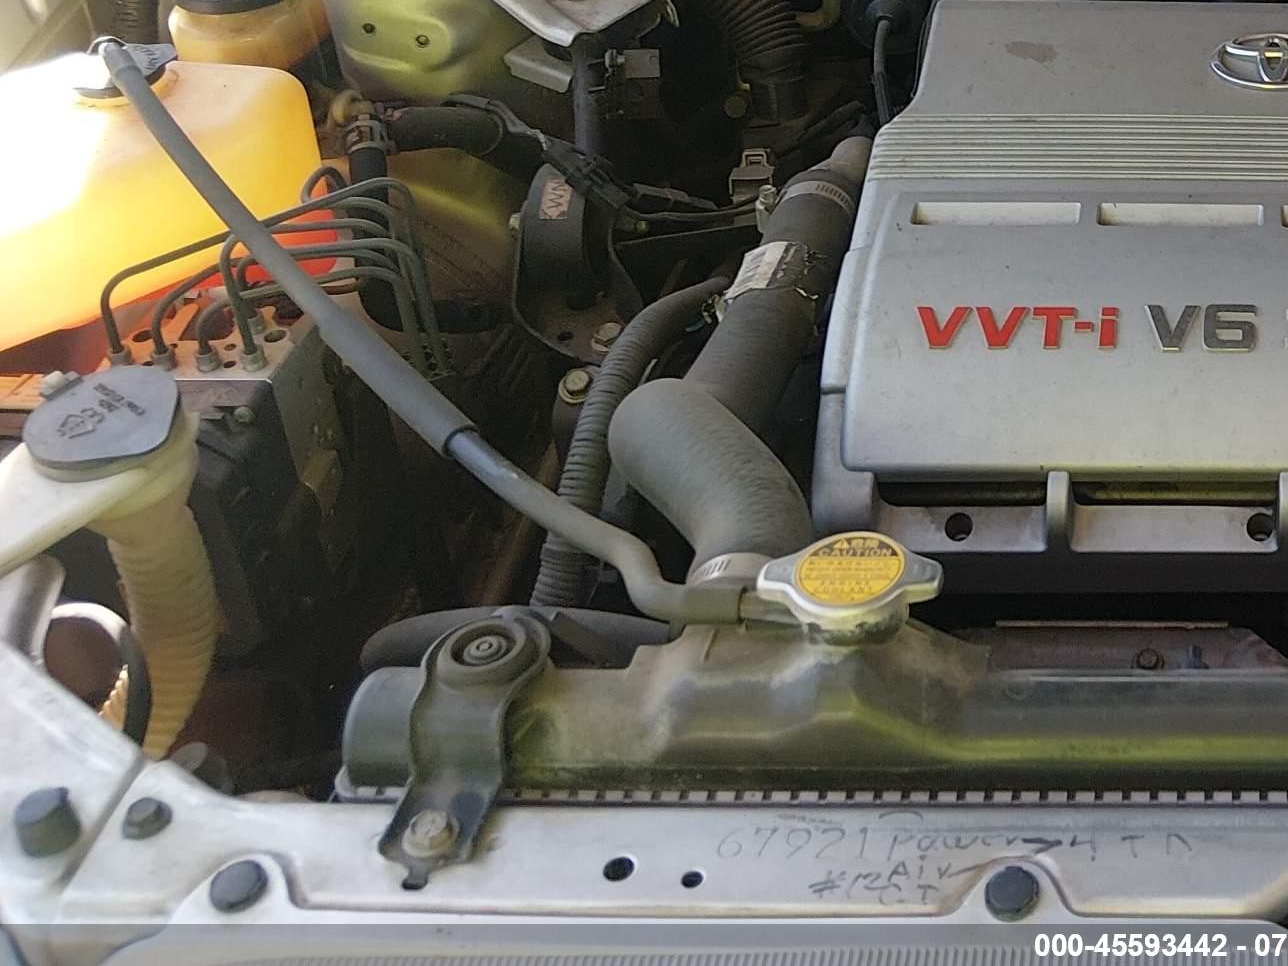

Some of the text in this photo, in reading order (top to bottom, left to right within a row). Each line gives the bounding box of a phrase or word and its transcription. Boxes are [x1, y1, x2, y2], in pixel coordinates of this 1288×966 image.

[917, 306, 1119, 350] VVT-i
[1144, 304, 1260, 353] V6
[820, 548, 893, 556] CAUTION
